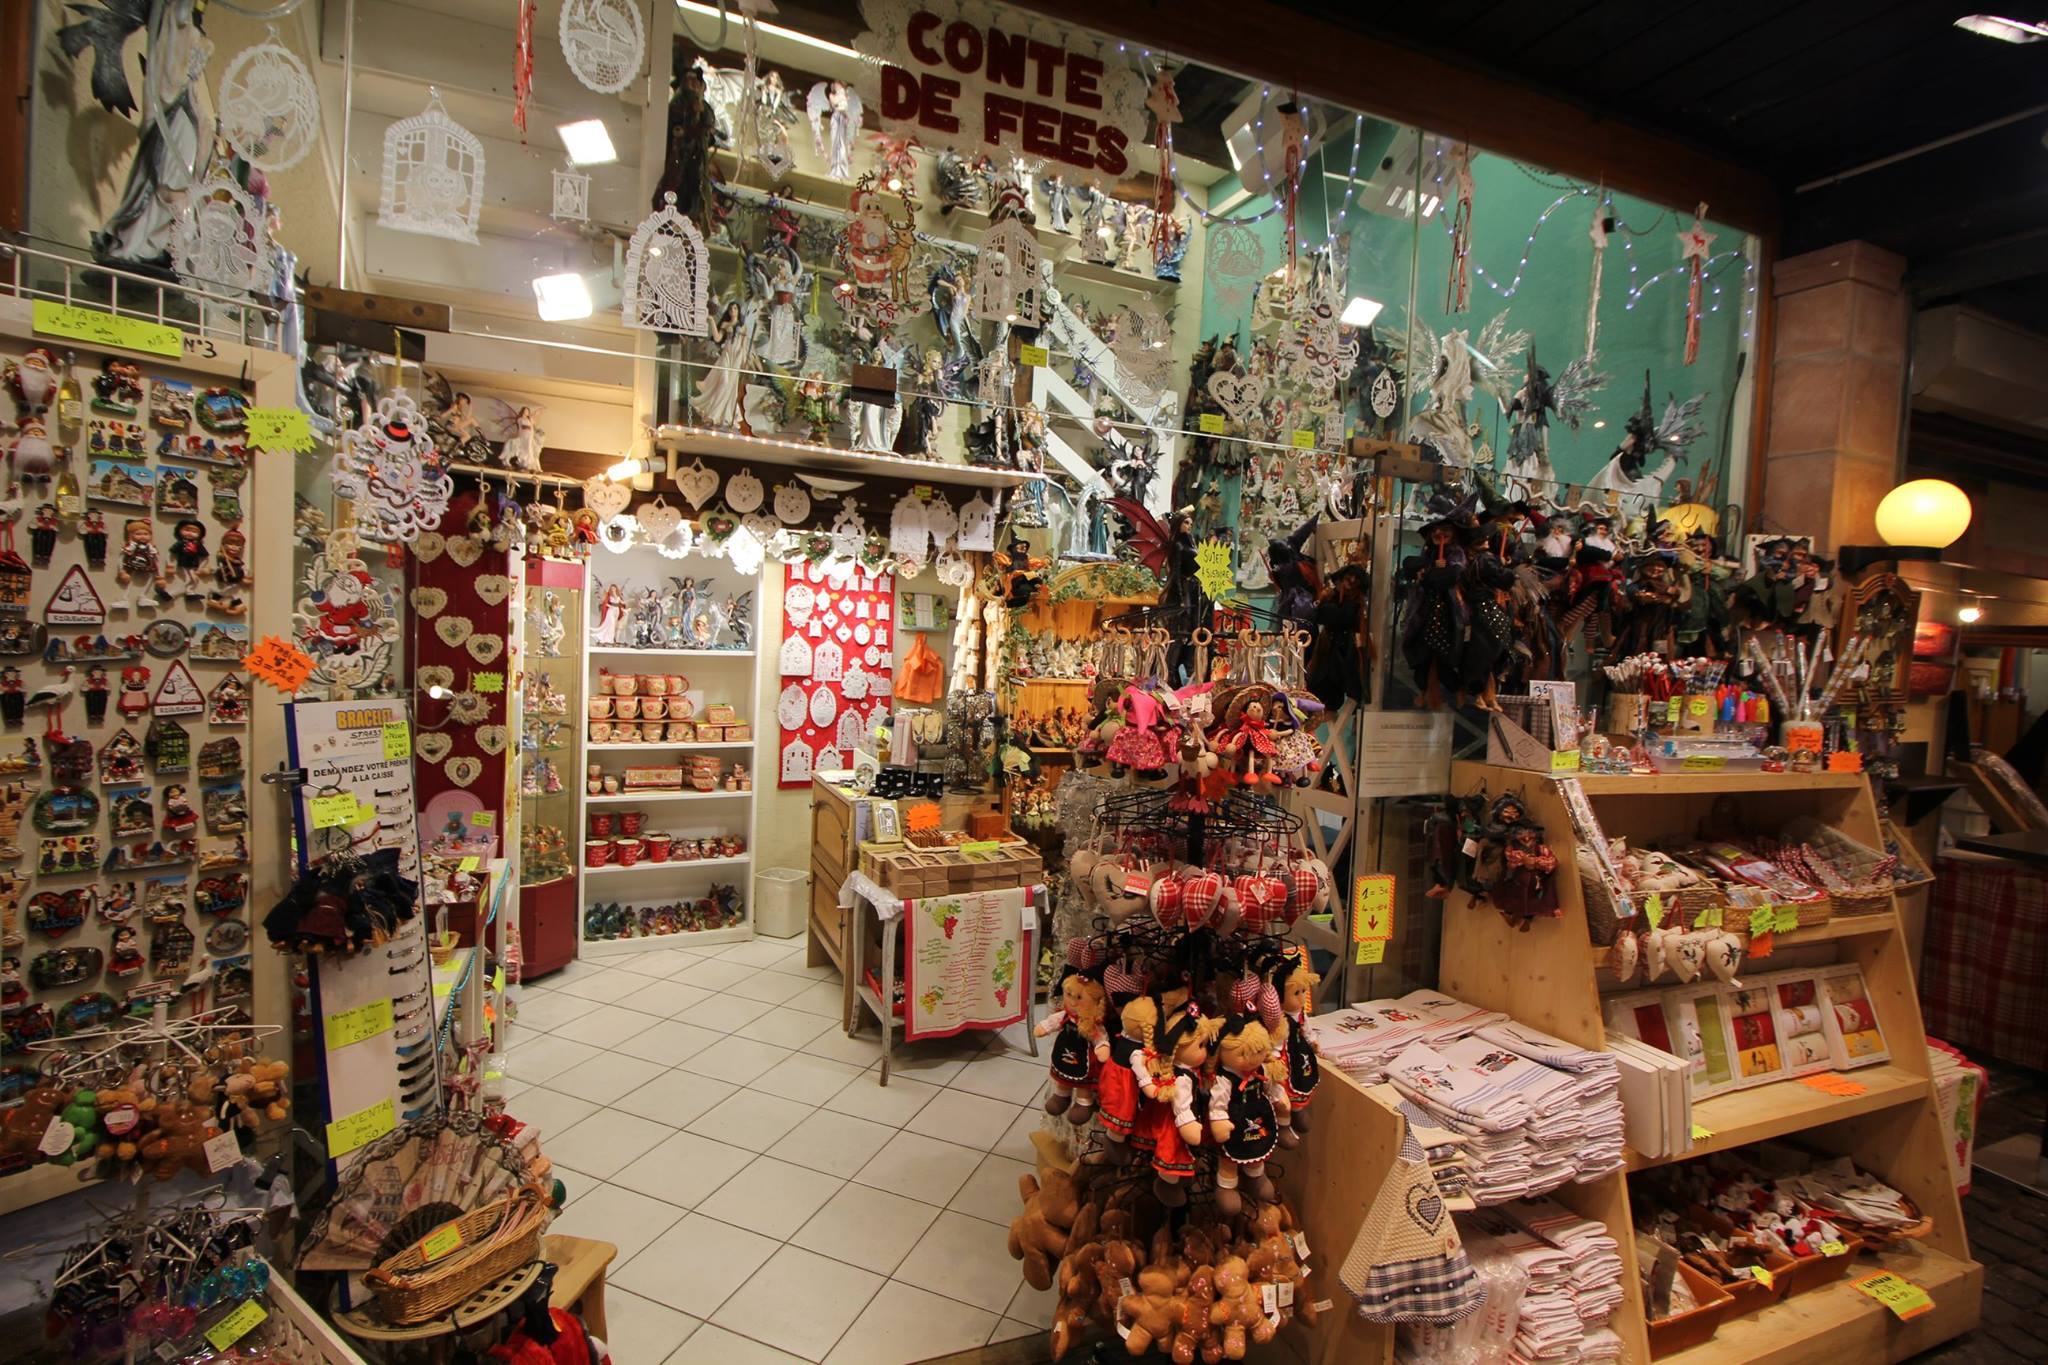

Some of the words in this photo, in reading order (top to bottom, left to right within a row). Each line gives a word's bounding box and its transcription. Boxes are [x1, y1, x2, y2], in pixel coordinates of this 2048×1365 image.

[906, 9, 1104, 110] CONTE
[880, 64, 961, 134] DE
[983, 91, 1129, 176] FEES
[313, 764, 365, 778] DEMANDEZ
[366, 761, 388, 772] VOTRE
[359, 773, 370, 782] LA
[371, 771, 395, 781] CAISSE
[335, 1099, 394, 1132] EVENTAIL
